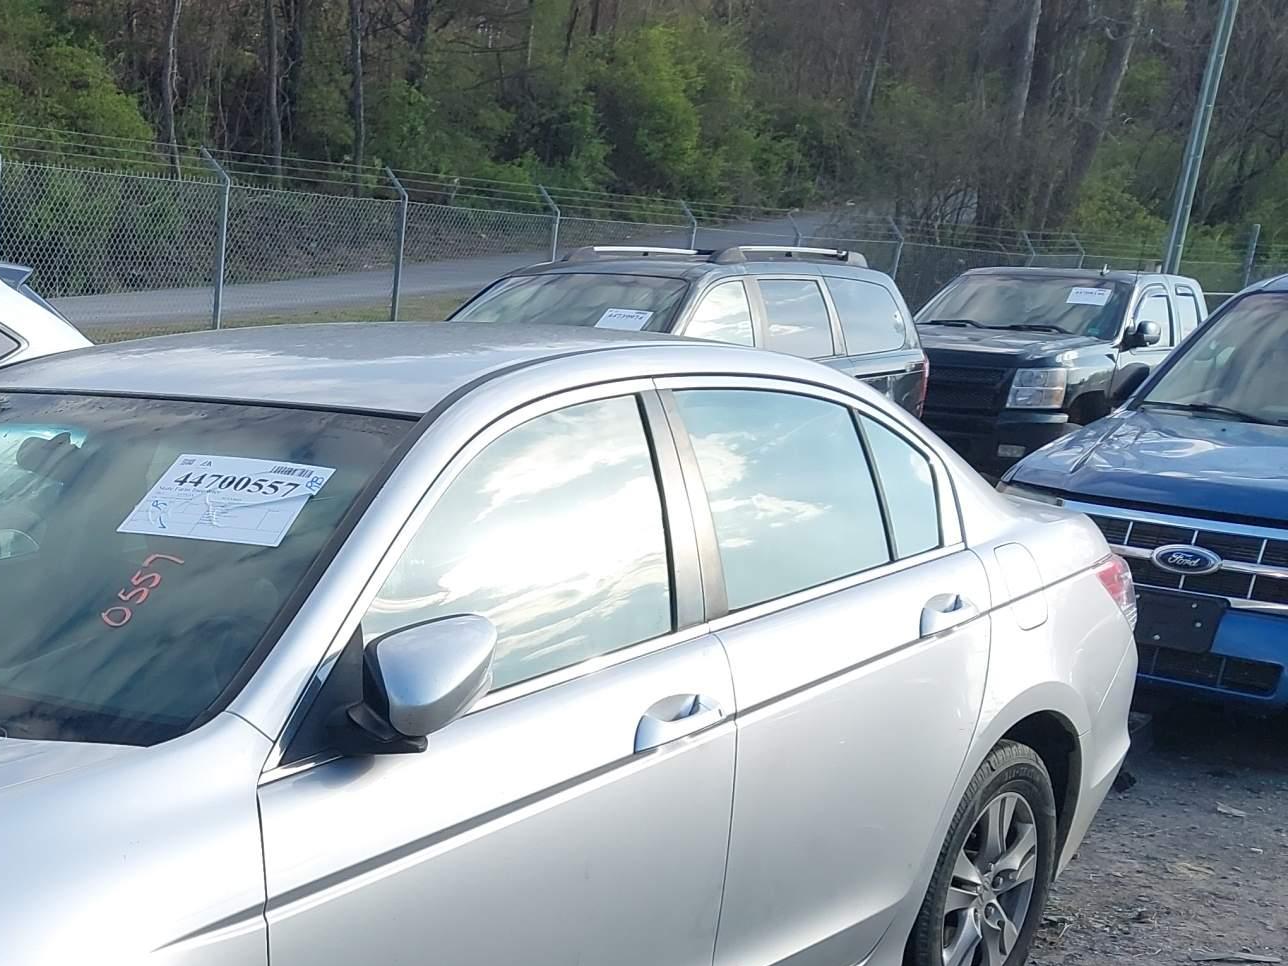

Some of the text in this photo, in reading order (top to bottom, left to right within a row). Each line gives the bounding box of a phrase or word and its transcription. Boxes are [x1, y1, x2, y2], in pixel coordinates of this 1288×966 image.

[174, 471, 301, 498] 44700557
[1168, 552, 1201, 567] Ford
[101, 553, 185, 627] 0557
